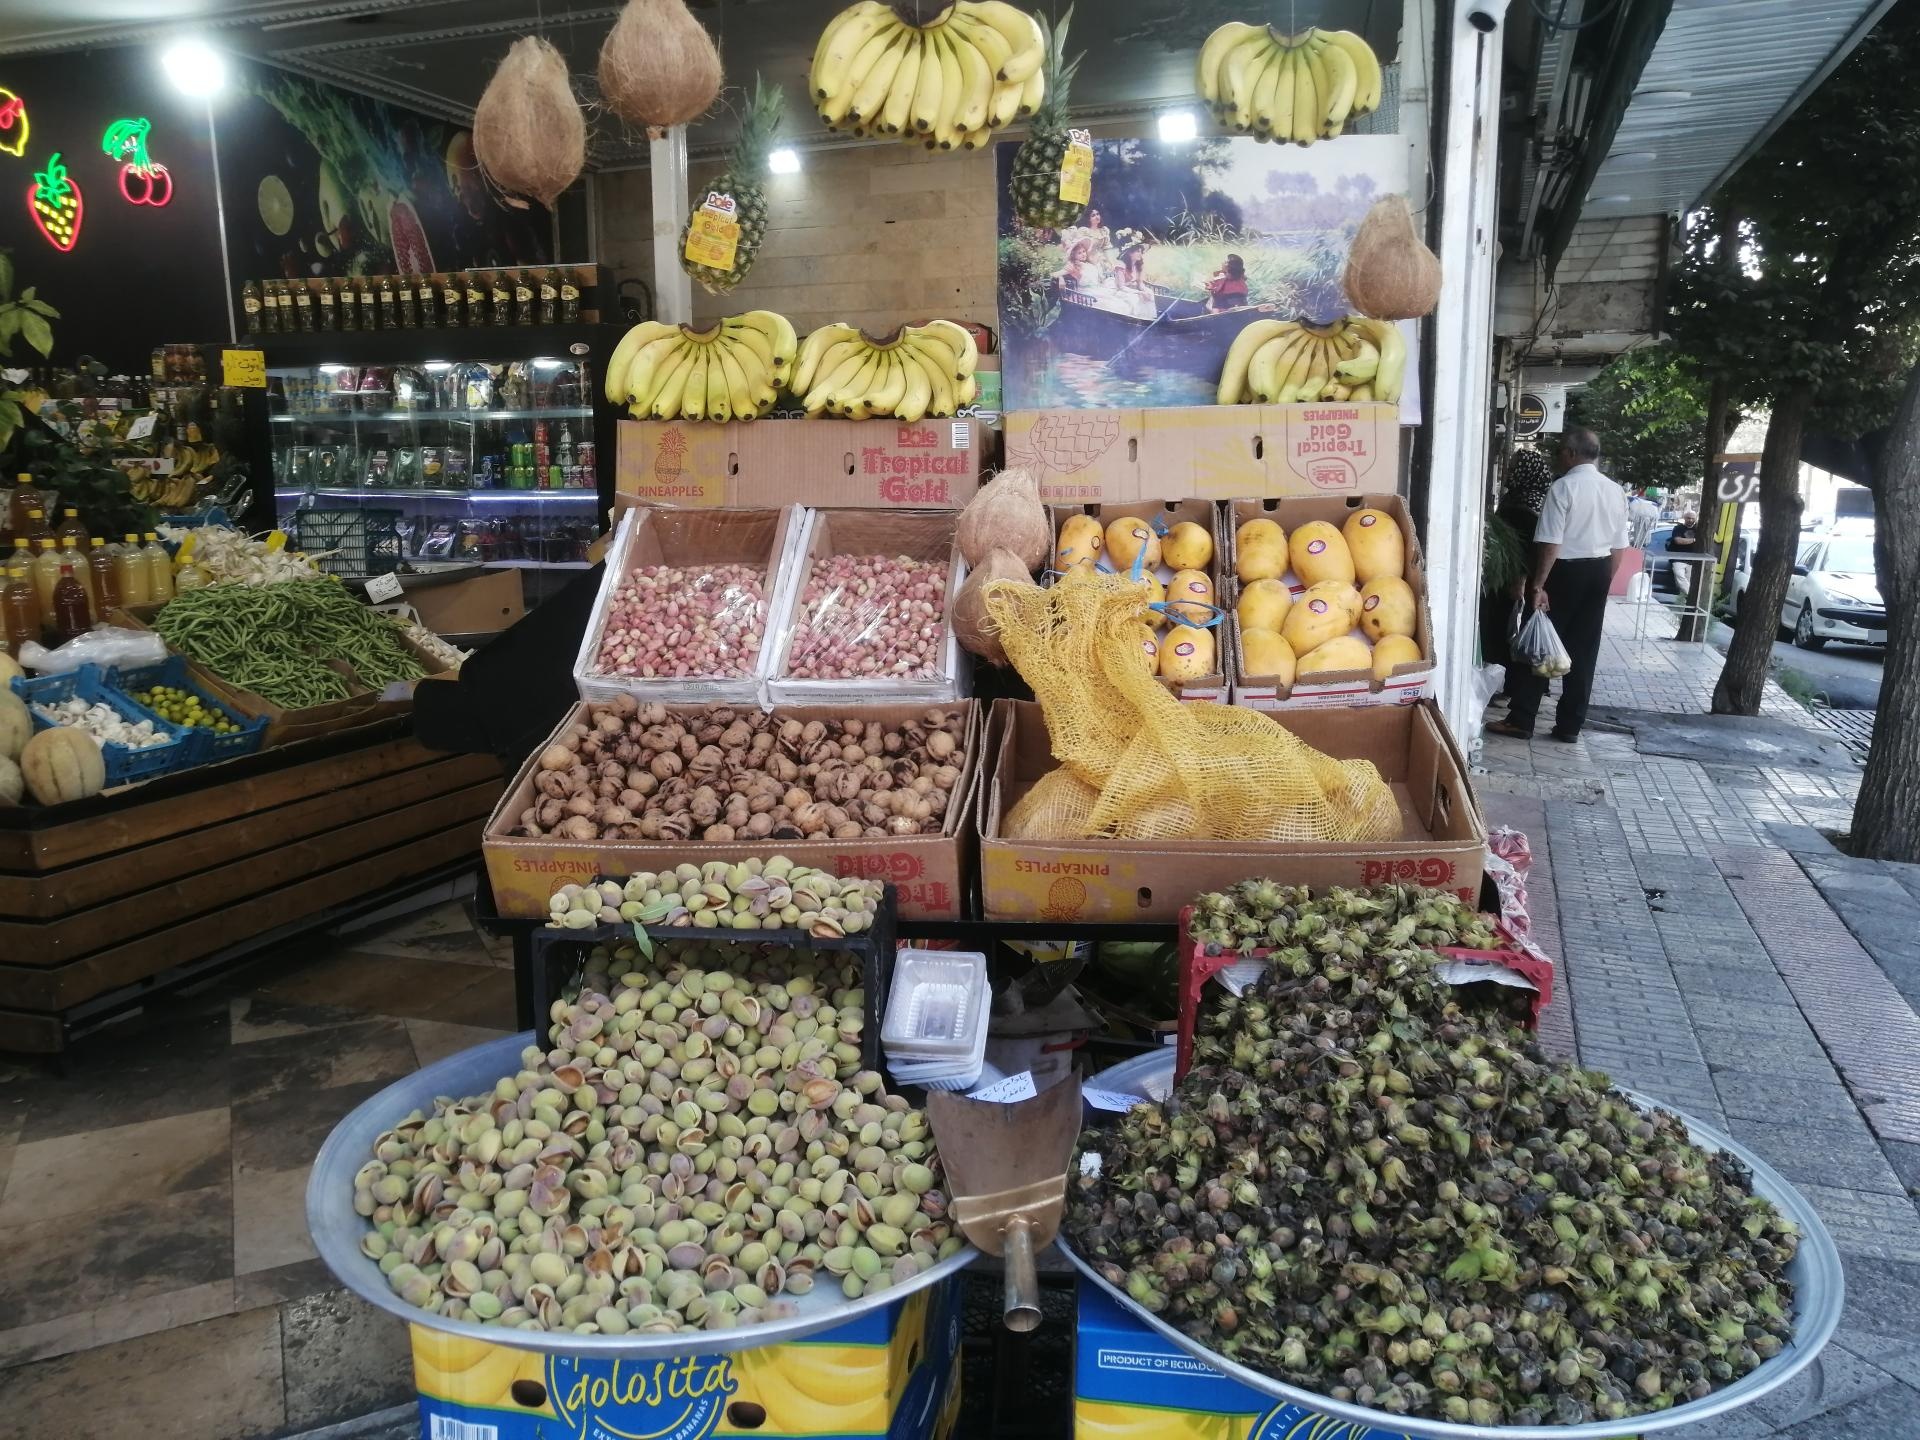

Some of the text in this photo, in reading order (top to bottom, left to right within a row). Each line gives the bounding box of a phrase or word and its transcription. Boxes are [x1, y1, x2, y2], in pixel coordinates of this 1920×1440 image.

[709, 193, 733, 209] Dole
[1303, 408, 1359, 421] PINEAPPLES
[897, 427, 938, 446] Dole
[1310, 423, 1352, 440] Gold
[1297, 439, 1367, 457] Tropical
[862, 447, 970, 480] Tropical
[1316, 469, 1346, 484] Dole
[637, 485, 704, 497] PINEAPPLES
[879, 475, 953, 503] Gold
[513, 859, 602, 875] PINEAPPLES
[834, 852, 926, 881] Gold
[1015, 860, 1110, 876] PINEAPPLES
[1360, 857, 1457, 887] Gold
[1103, 1354, 1152, 1367] PRODUCT
[1153, 1359, 1169, 1368] OF
[566, 1355, 735, 1425] golosita
[675, 1399, 709, 1439] BANANAS
